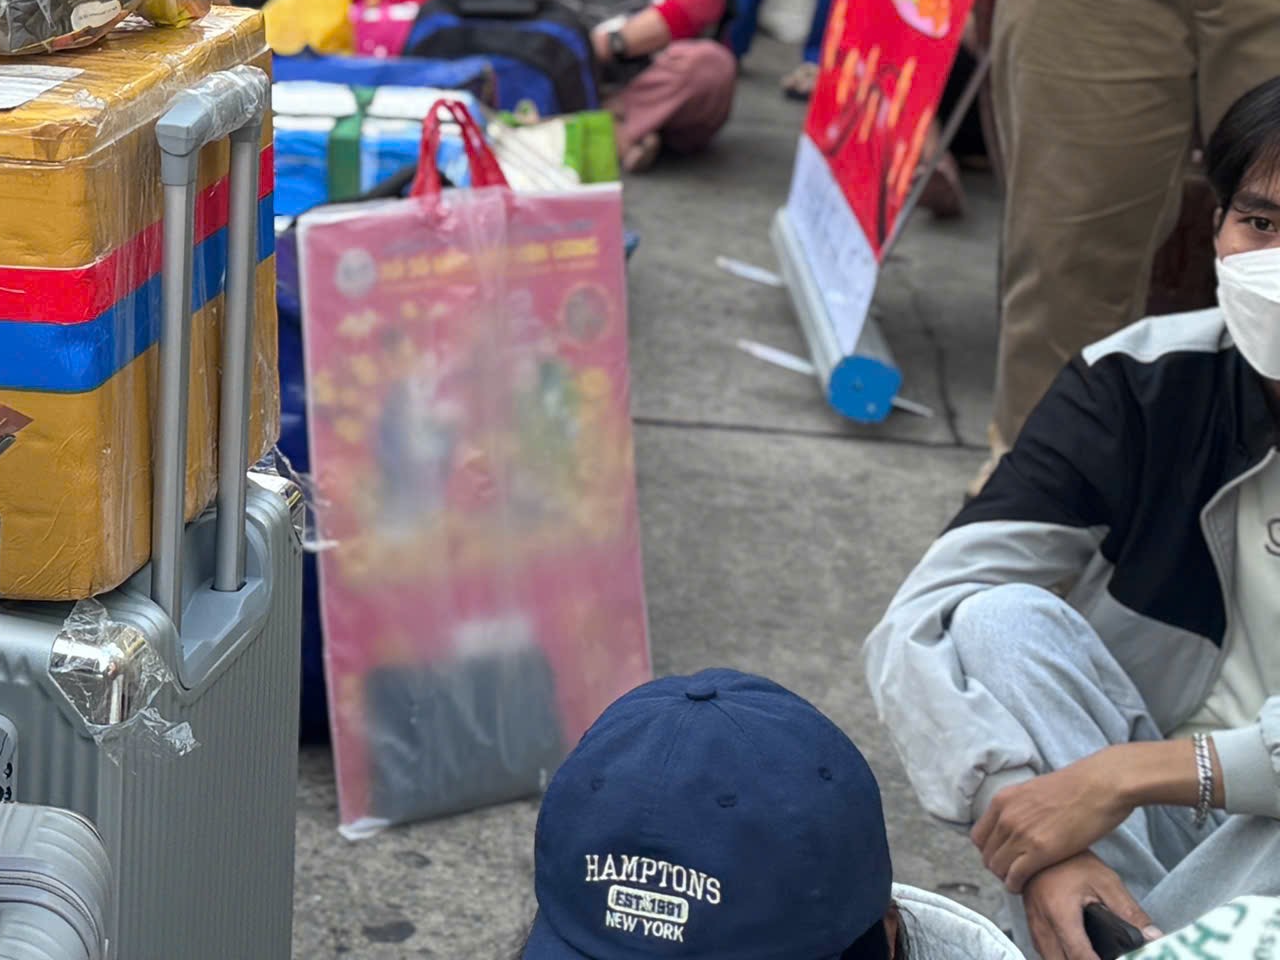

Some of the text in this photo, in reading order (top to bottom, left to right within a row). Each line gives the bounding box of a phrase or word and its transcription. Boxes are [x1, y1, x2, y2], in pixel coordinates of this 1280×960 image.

[585, 854, 721, 904] HAMPTONS
[605, 910, 684, 942] NEW YORK
